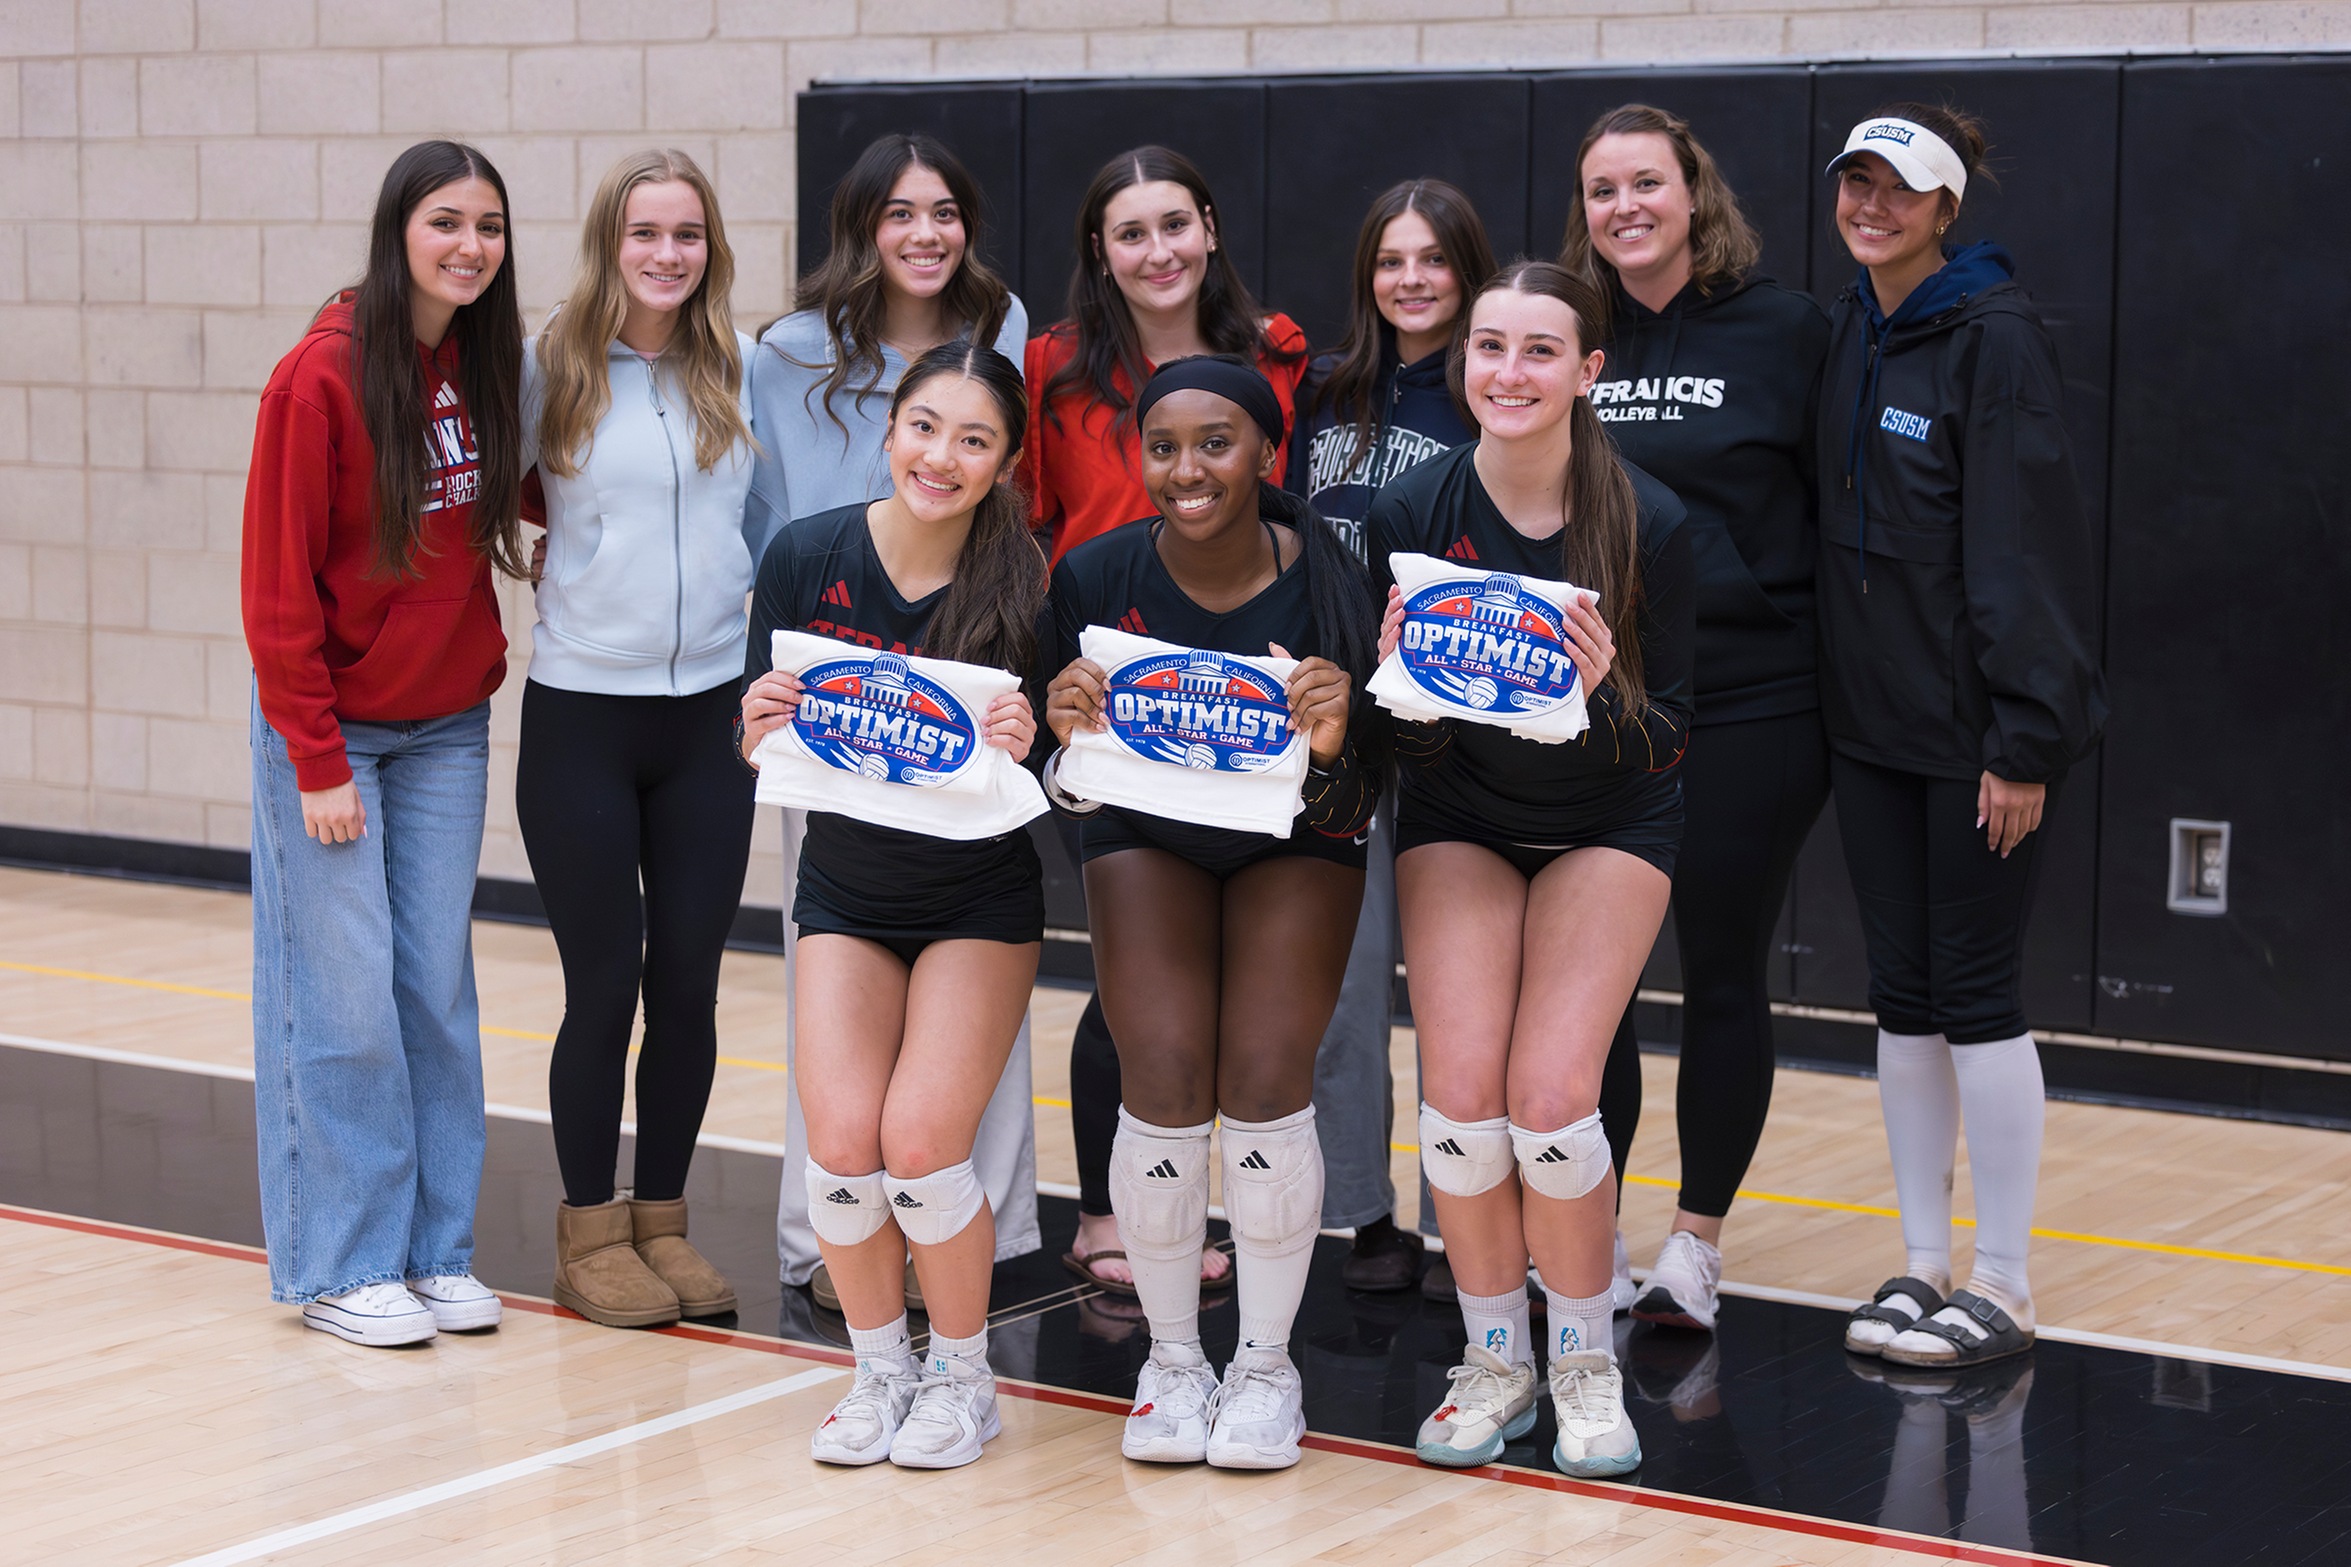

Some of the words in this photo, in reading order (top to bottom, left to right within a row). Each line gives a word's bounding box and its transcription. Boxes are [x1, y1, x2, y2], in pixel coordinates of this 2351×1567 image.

[1866, 125, 1912, 144] CSUSM
[1880, 406, 1932, 441] CSUSM
[445, 469, 482, 494] ROCK
[1417, 586, 1482, 610] SACRAMENTO
[1519, 597, 1566, 640] CALIFORNIA
[1453, 619, 1531, 642] BREAKFAST
[1404, 620, 1572, 684] OPTIMIST
[1123, 658, 1187, 684] SACRAMENTO
[1224, 665, 1277, 700] CALIFORNIA
[1425, 654, 1448, 665] ALL
[1460, 659, 1493, 674] STAR
[1504, 670, 1538, 688] GAME
[810, 665, 871, 686] SACRAMENTO
[906, 677, 957, 721] CALIFORNIA
[1162, 691, 1239, 706] BREAKFAST
[1524, 695, 1552, 706] OPTIMIST
[844, 696, 920, 720] BREAKFAST
[1114, 693, 1287, 741] OPTIMIST
[800, 694, 965, 762] OPTIMIST
[1143, 724, 1165, 734] ALL
[1177, 728, 1208, 740] STAR
[1219, 734, 1254, 748] GAME
[824, 727, 845, 740] ALL
[853, 738, 883, 752] STAR
[894, 746, 929, 766] GAME
[915, 772, 943, 781] OPTIMIST
[826, 1195, 860, 1205] adidas
[894, 1198, 923, 1209] adidas
